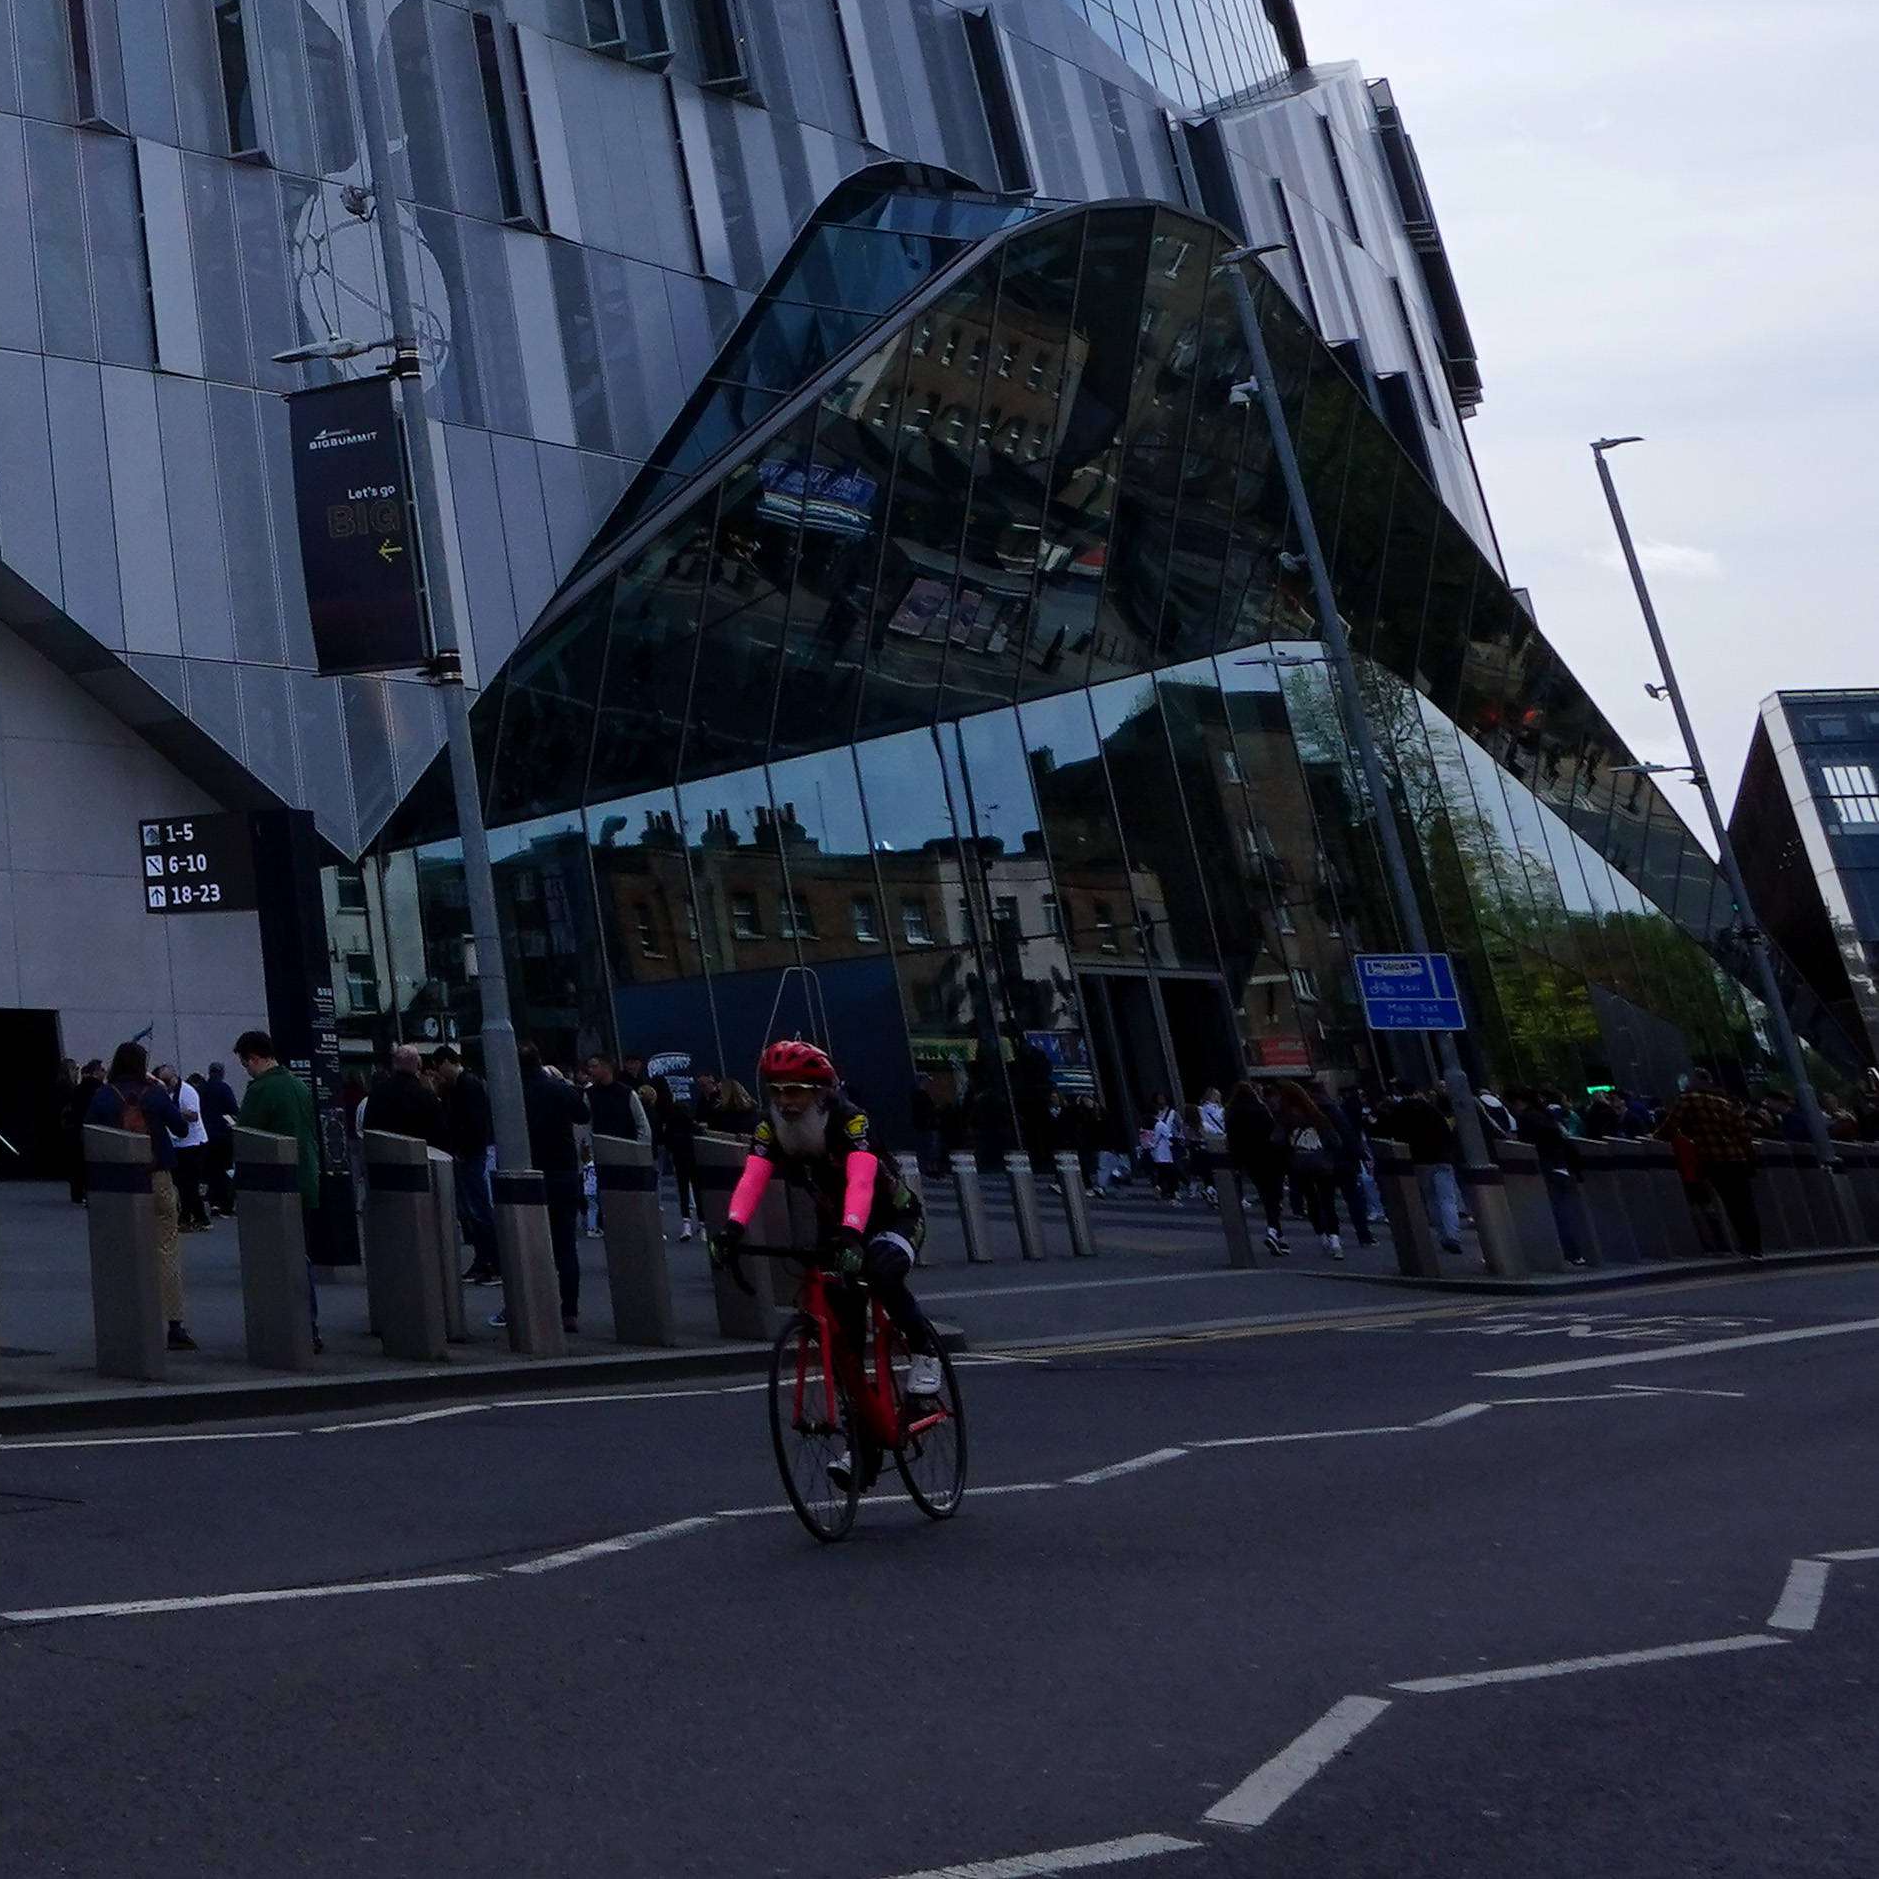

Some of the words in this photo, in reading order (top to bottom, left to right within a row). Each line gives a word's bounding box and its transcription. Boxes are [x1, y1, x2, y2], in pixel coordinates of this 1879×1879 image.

[348, 487, 378, 500] Let's
[380, 485, 396, 498] go
[327, 500, 400, 538] BIG
[165, 822, 195, 843] 1-5
[168, 853, 208, 874] 6-10
[171, 883, 222, 905] 18-23
